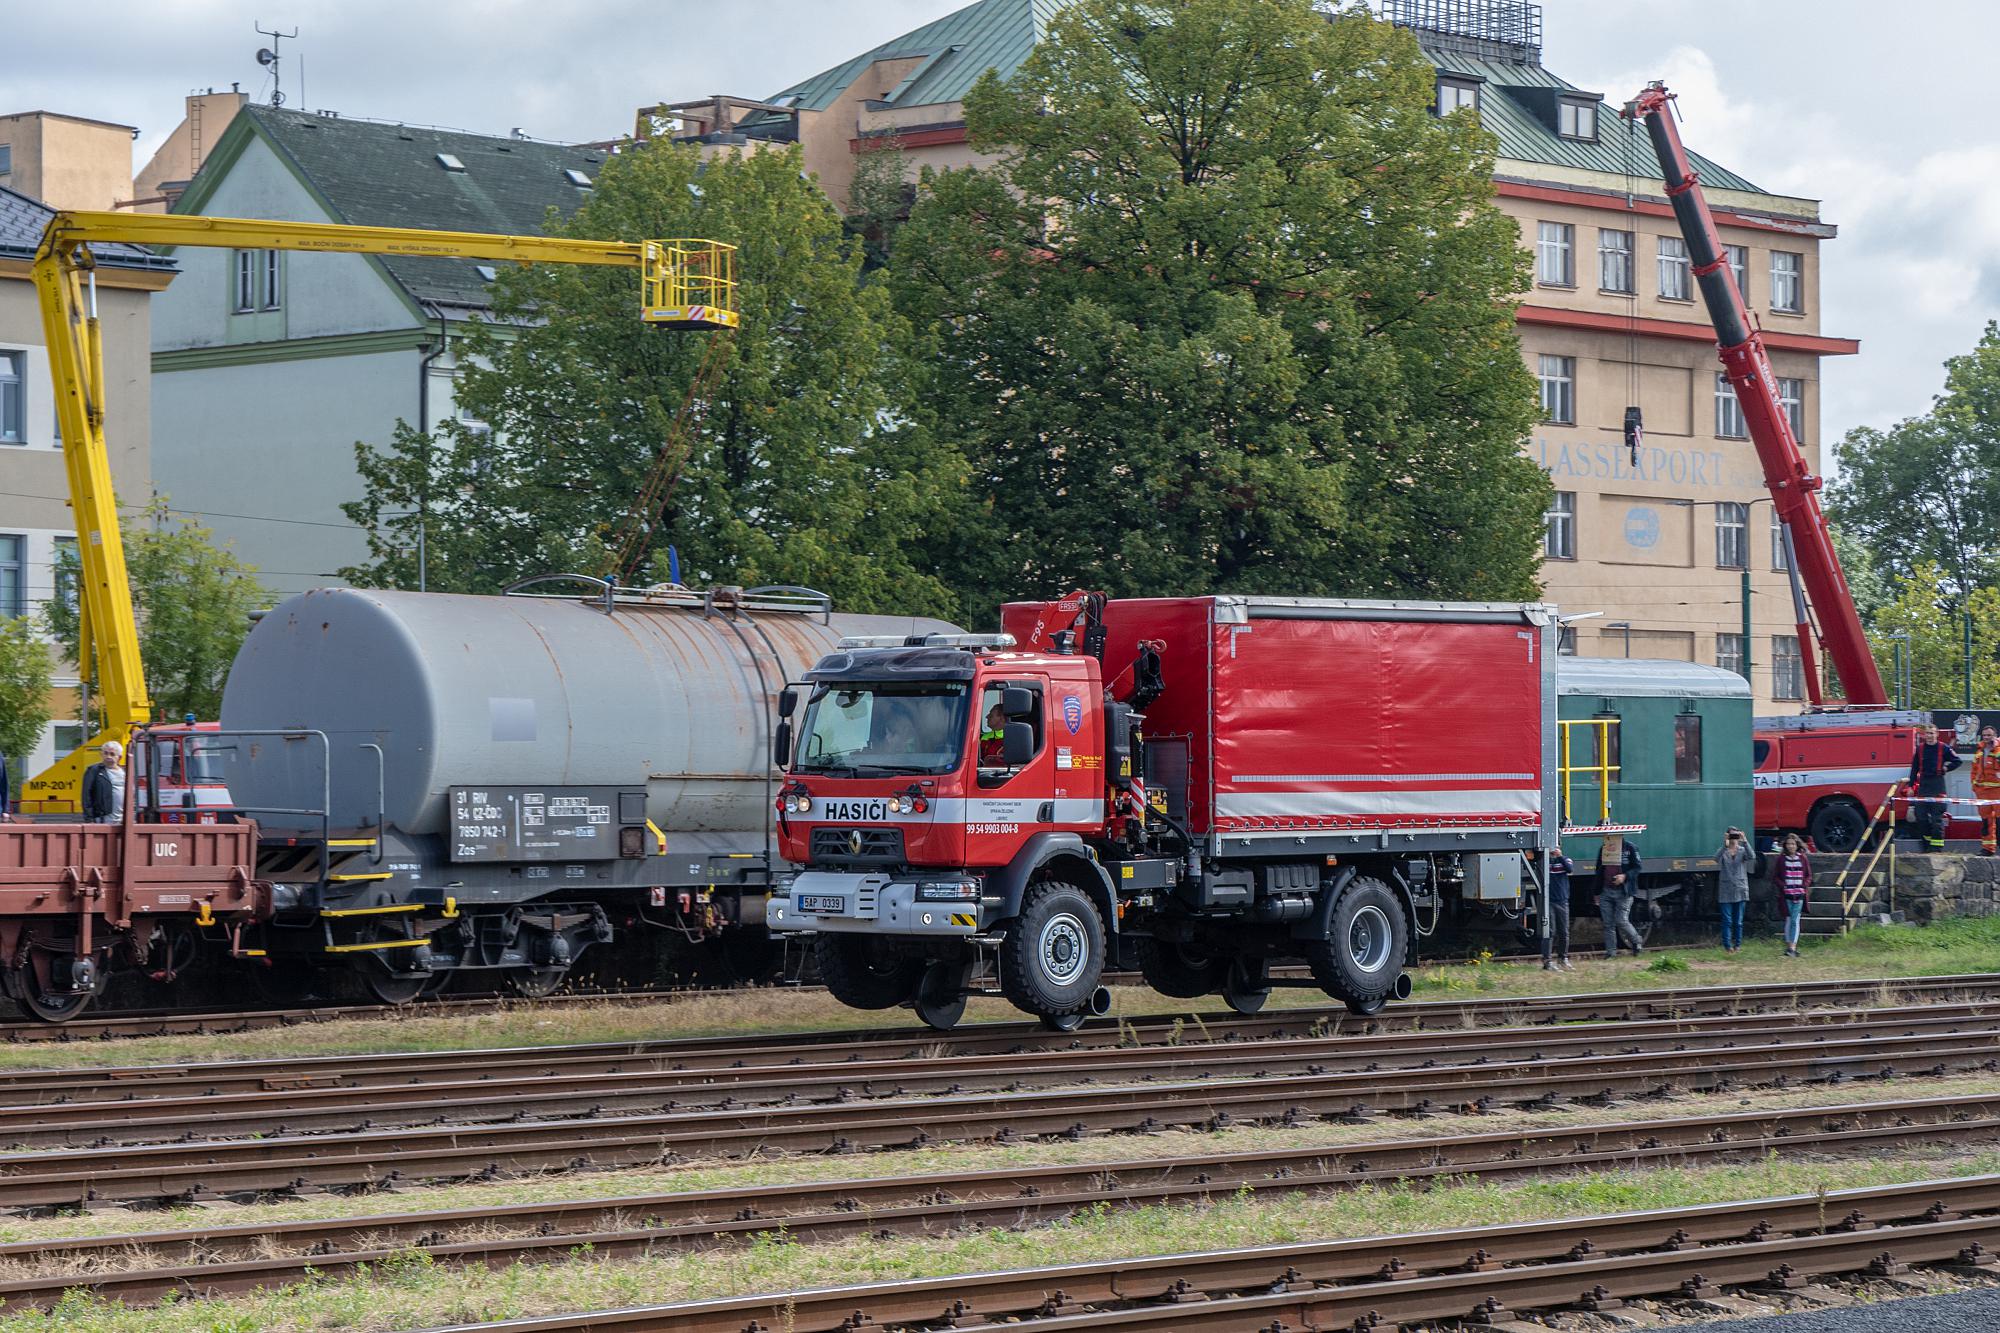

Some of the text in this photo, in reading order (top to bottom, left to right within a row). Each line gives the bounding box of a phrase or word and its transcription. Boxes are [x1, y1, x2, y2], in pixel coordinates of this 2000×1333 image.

[1531, 439, 1724, 488] LASSEXPORT
[457, 791, 488, 804] 31 RIV
[457, 807, 470, 820] 54
[825, 799, 887, 820] HASIČI
[459, 825, 506, 838] 7850 742-1
[966, 823, 1019, 834] 99 54 9903 004-8
[155, 843, 178, 857] UIC
[804, 897, 840, 909] 5AP 0339
